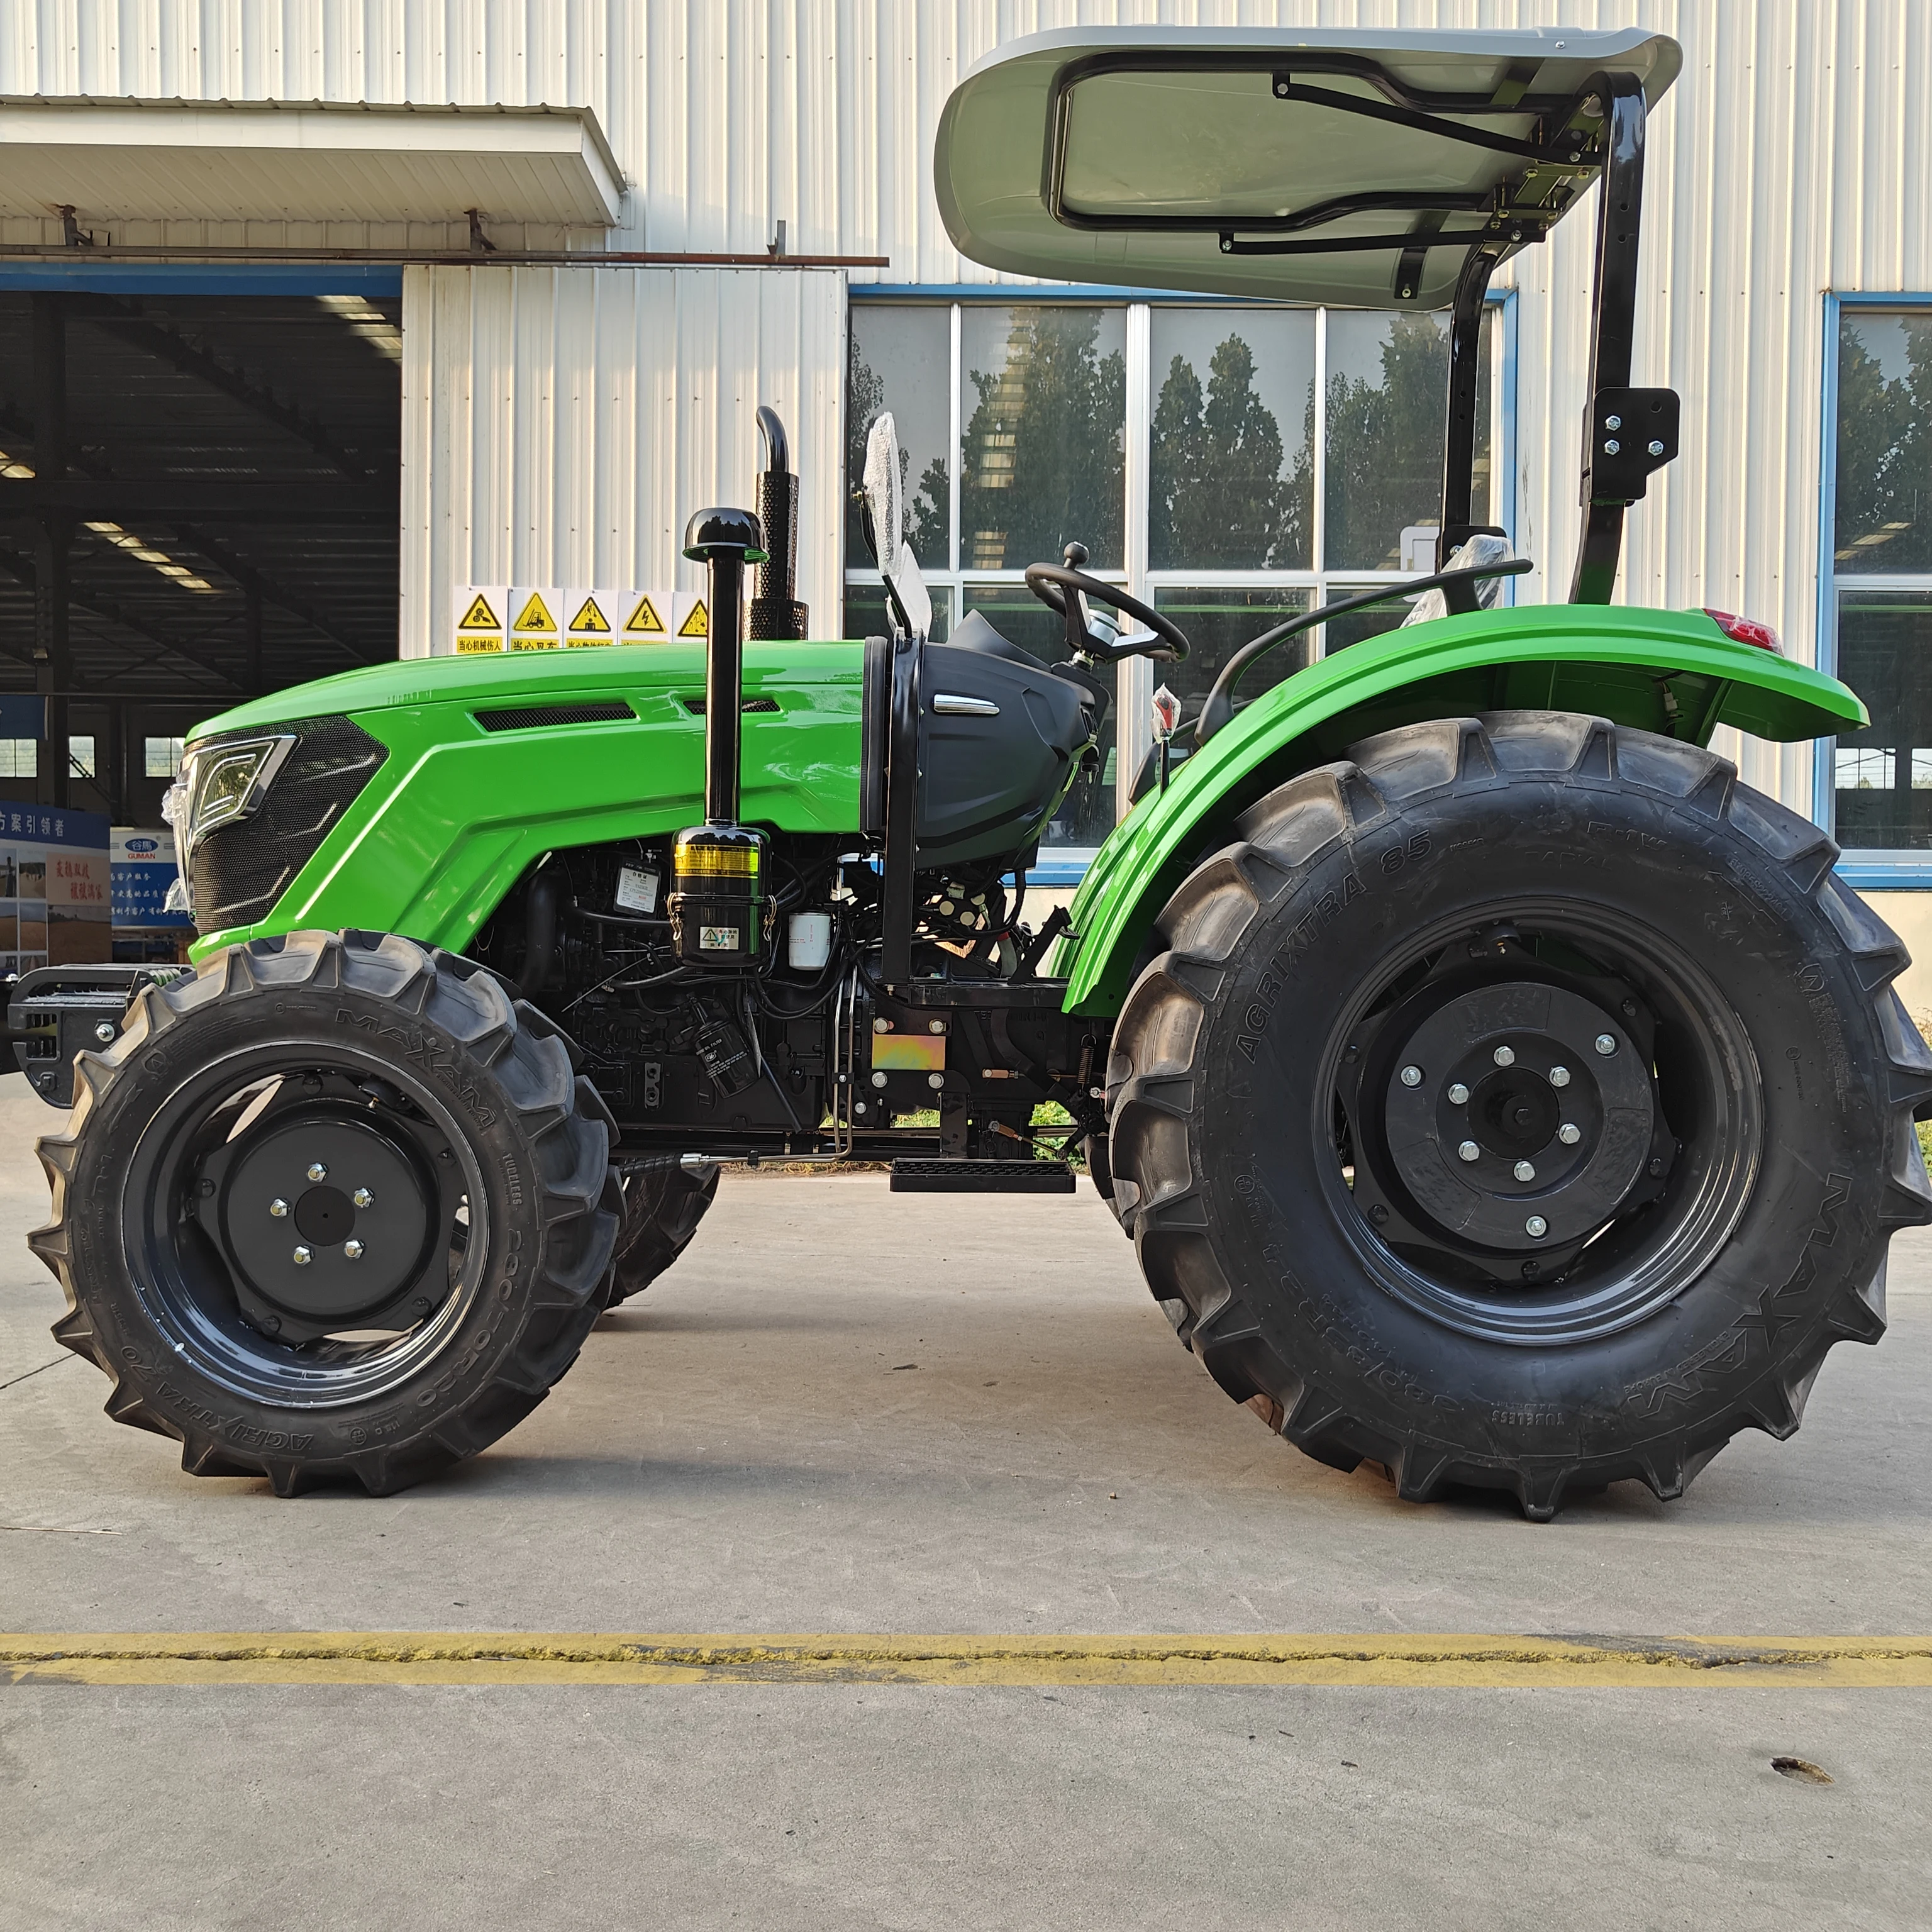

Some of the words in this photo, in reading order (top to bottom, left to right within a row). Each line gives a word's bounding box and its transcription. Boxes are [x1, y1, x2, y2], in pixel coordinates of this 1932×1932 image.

[458, 639, 501, 651] 当心机械伤人
[1234, 870, 1368, 1064] AGRIXTRA
[1377, 831, 1435, 876] 85
[335, 1006, 496, 1130] MAXAM
[503, 1152, 523, 1206] TUBELESS
[415, 1229, 522, 1409] 280/70R20
[1626, 1171, 1857, 1425] MAXAM
[119, 1343, 158, 1384] 70
[155, 1380, 314, 1450] AGRIXTRA
[1489, 1407, 1564, 1428] TUBELESS
